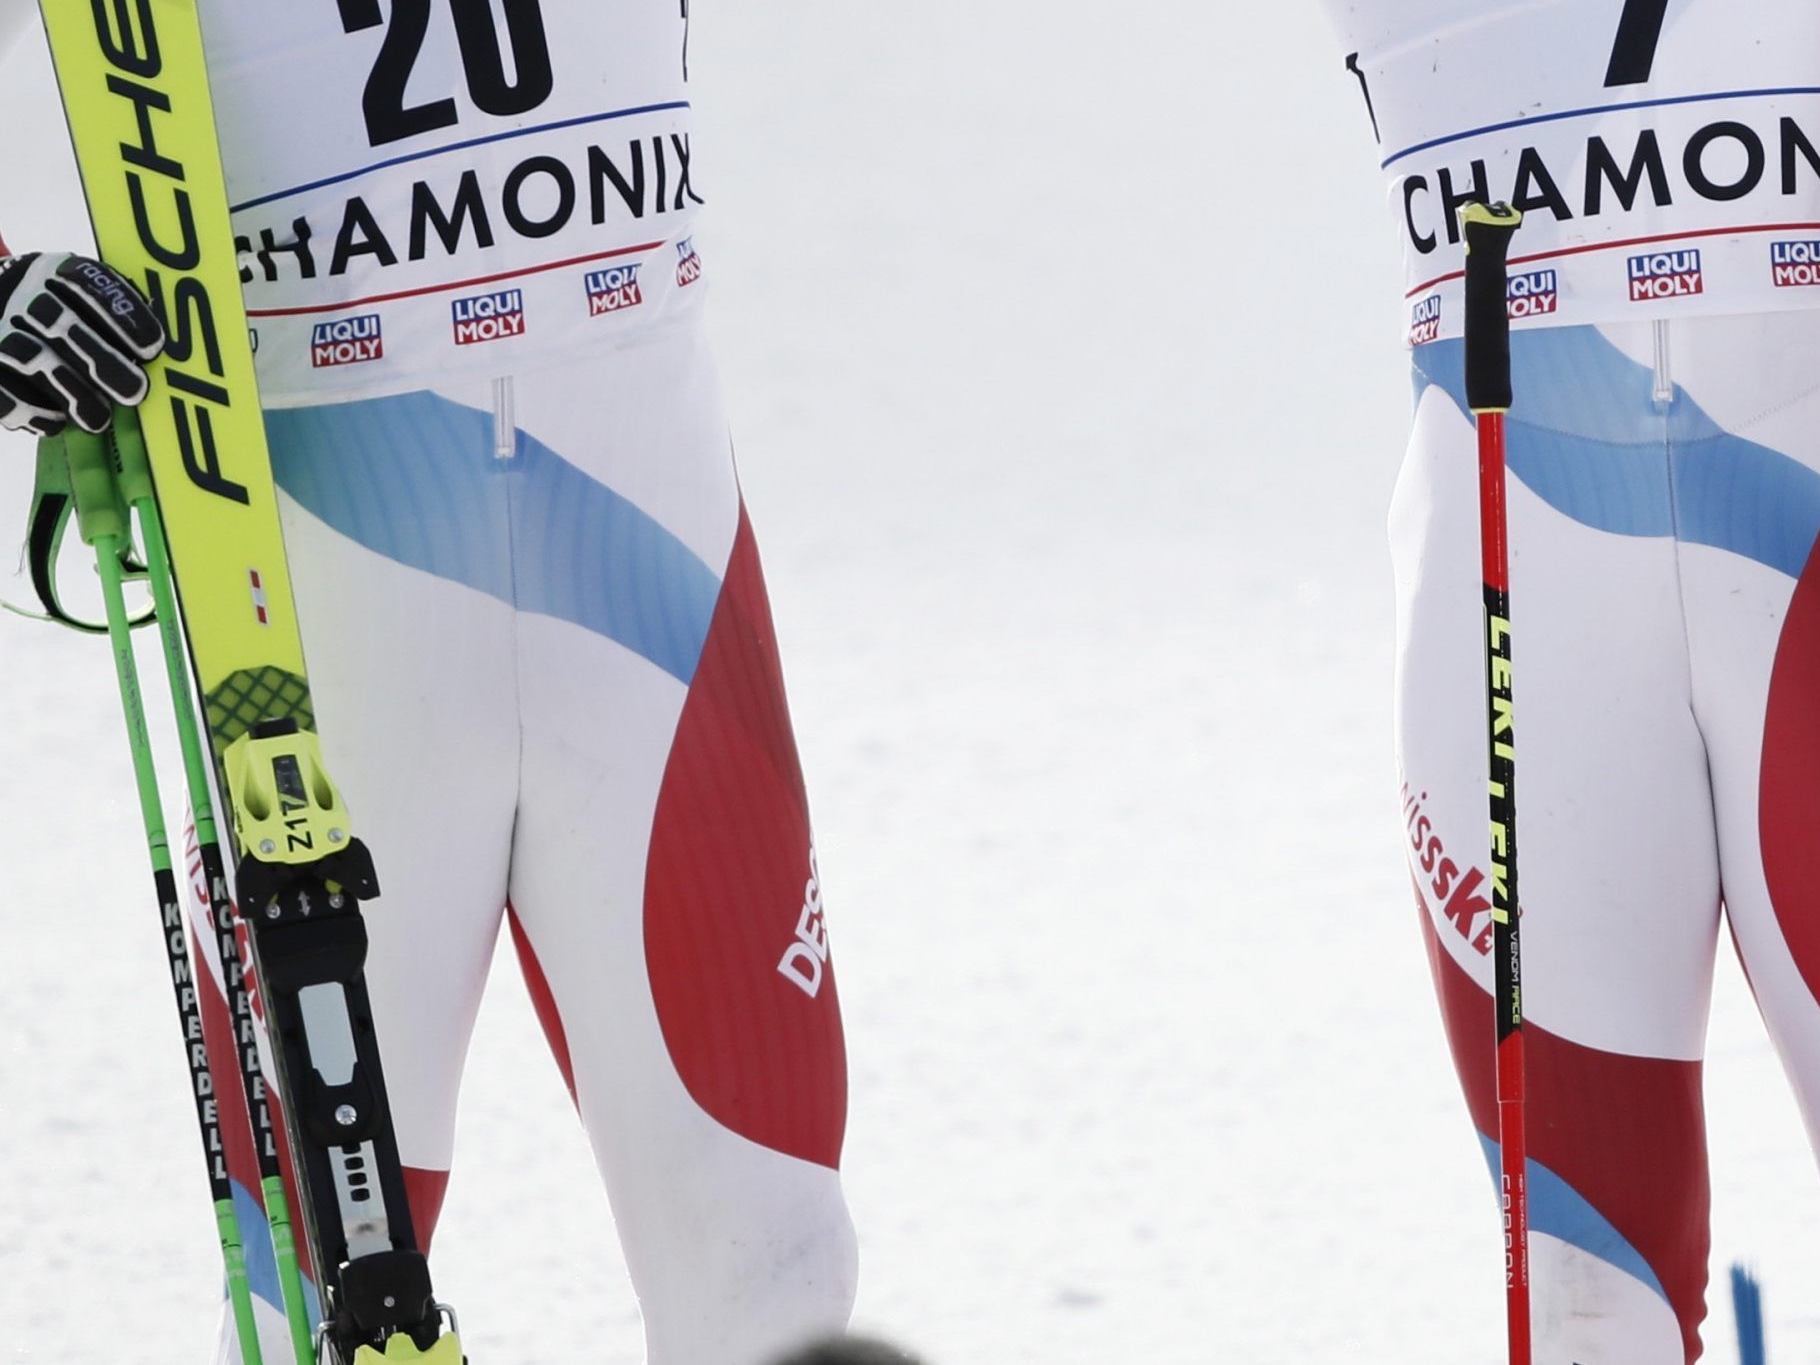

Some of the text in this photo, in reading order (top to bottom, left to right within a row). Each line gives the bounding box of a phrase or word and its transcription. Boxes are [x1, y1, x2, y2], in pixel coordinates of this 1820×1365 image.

[1631, 251, 1698, 279] LIQUI
[76, 262, 136, 318] racing
[589, 283, 642, 314] MOLY
[1507, 271, 1554, 298] IQUI
[1632, 273, 1702, 300] MOLY
[454, 291, 521, 321] LIQUI
[1507, 294, 1555, 317] OLY
[314, 316, 379, 344] LIQUI
[456, 314, 524, 342] MOLY
[314, 339, 383, 365] MOLY
[1490, 615, 1515, 762] LEKI
[1510, 930, 1520, 982] VENOM
[212, 876, 278, 1156] KOMPERDELL
[164, 902, 227, 1180] KOMPERDELL
